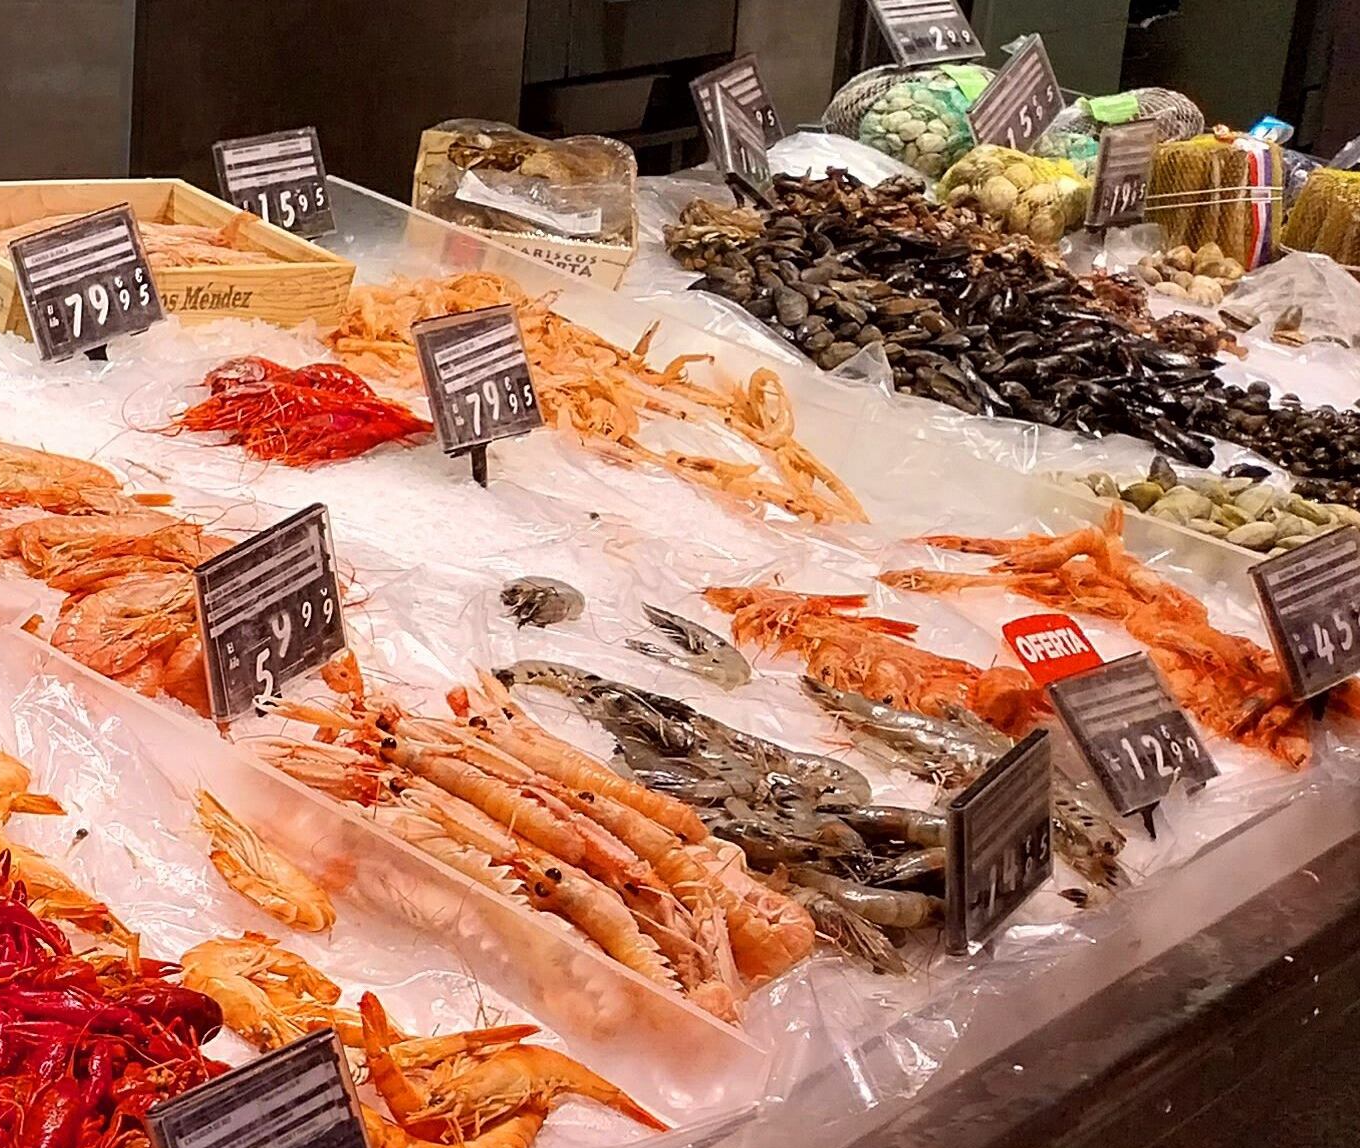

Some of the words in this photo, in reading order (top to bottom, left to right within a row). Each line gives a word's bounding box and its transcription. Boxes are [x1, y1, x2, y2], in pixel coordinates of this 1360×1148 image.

[506, 243, 597, 265] ARISCOS
[65, 284, 109, 338] 79
[180, 282, 253, 311] Méndez
[465, 381, 500, 436] 79
[1015, 627, 1089, 664] OFERTA
[1120, 735, 1174, 781] 12
